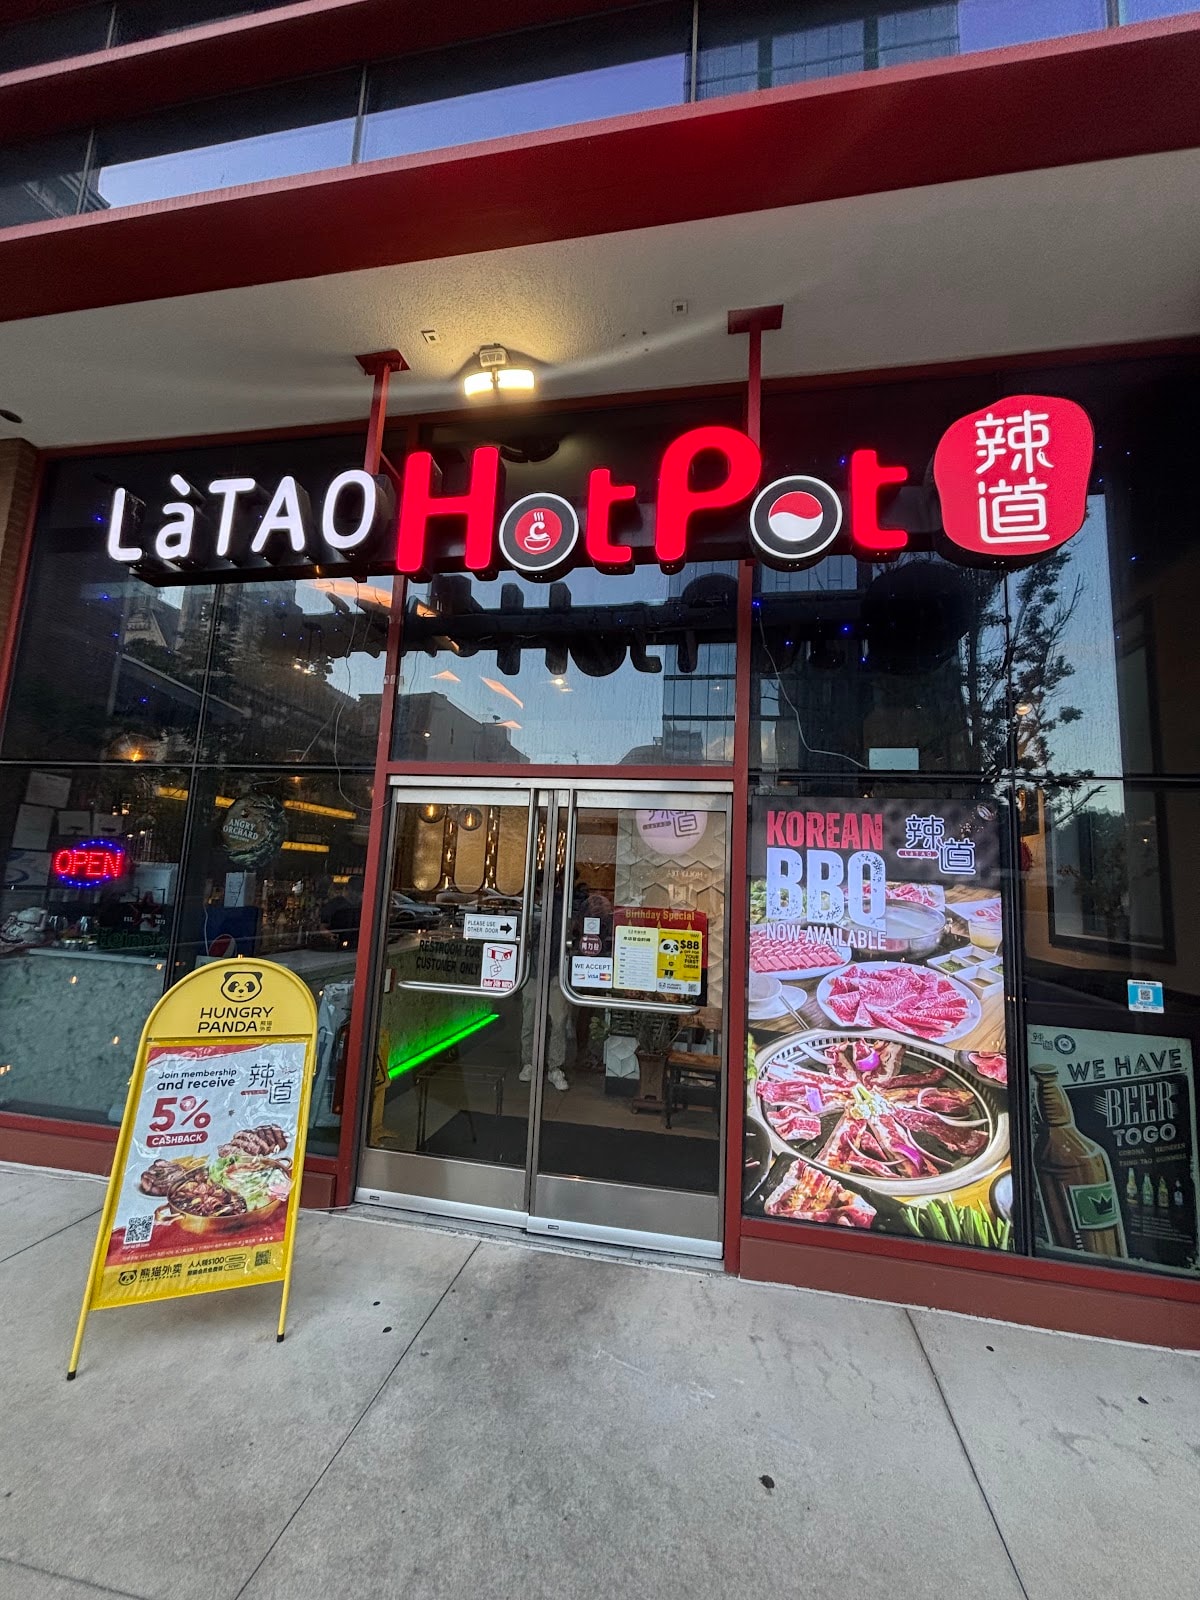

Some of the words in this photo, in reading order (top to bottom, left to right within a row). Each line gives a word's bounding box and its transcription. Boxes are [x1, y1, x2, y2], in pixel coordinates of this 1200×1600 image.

[974, 409, 1054, 544] 辣道
[223, 825, 259, 840] ORCHARD
[229, 819, 256, 831] ANGRY
[767, 811, 883, 850] KOREAN
[905, 814, 976, 875] 辣道
[55, 850, 122, 877] OPEN
[766, 847, 886, 931] BBQ
[625, 909, 660, 921] Birthday
[663, 910, 695, 921] Special
[766, 922, 800, 942] NOW
[805, 926, 887, 950] AVAILABLE
[419, 940, 462, 955] RESTROOM
[680, 939, 700, 950] $88
[415, 957, 457, 972] CUSTOMER
[460, 961, 480, 975] ONLY
[585, 963, 611, 971] ACCEPT
[200, 1006, 275, 1019] HUNGRY
[197, 1020, 258, 1033] PANDA
[159, 1071, 179, 1079] Join
[181, 1068, 237, 1079] membership
[1067, 1059, 1106, 1082] WE
[1115, 1049, 1183, 1077] HAVE
[157, 1080, 185, 1091] and
[187, 1077, 236, 1089] receive
[1105, 1081, 1174, 1127] BEER
[149, 1095, 211, 1132] 5%
[151, 1133, 203, 1146] CASHBACK
[1113, 1123, 1177, 1147] TOGO
